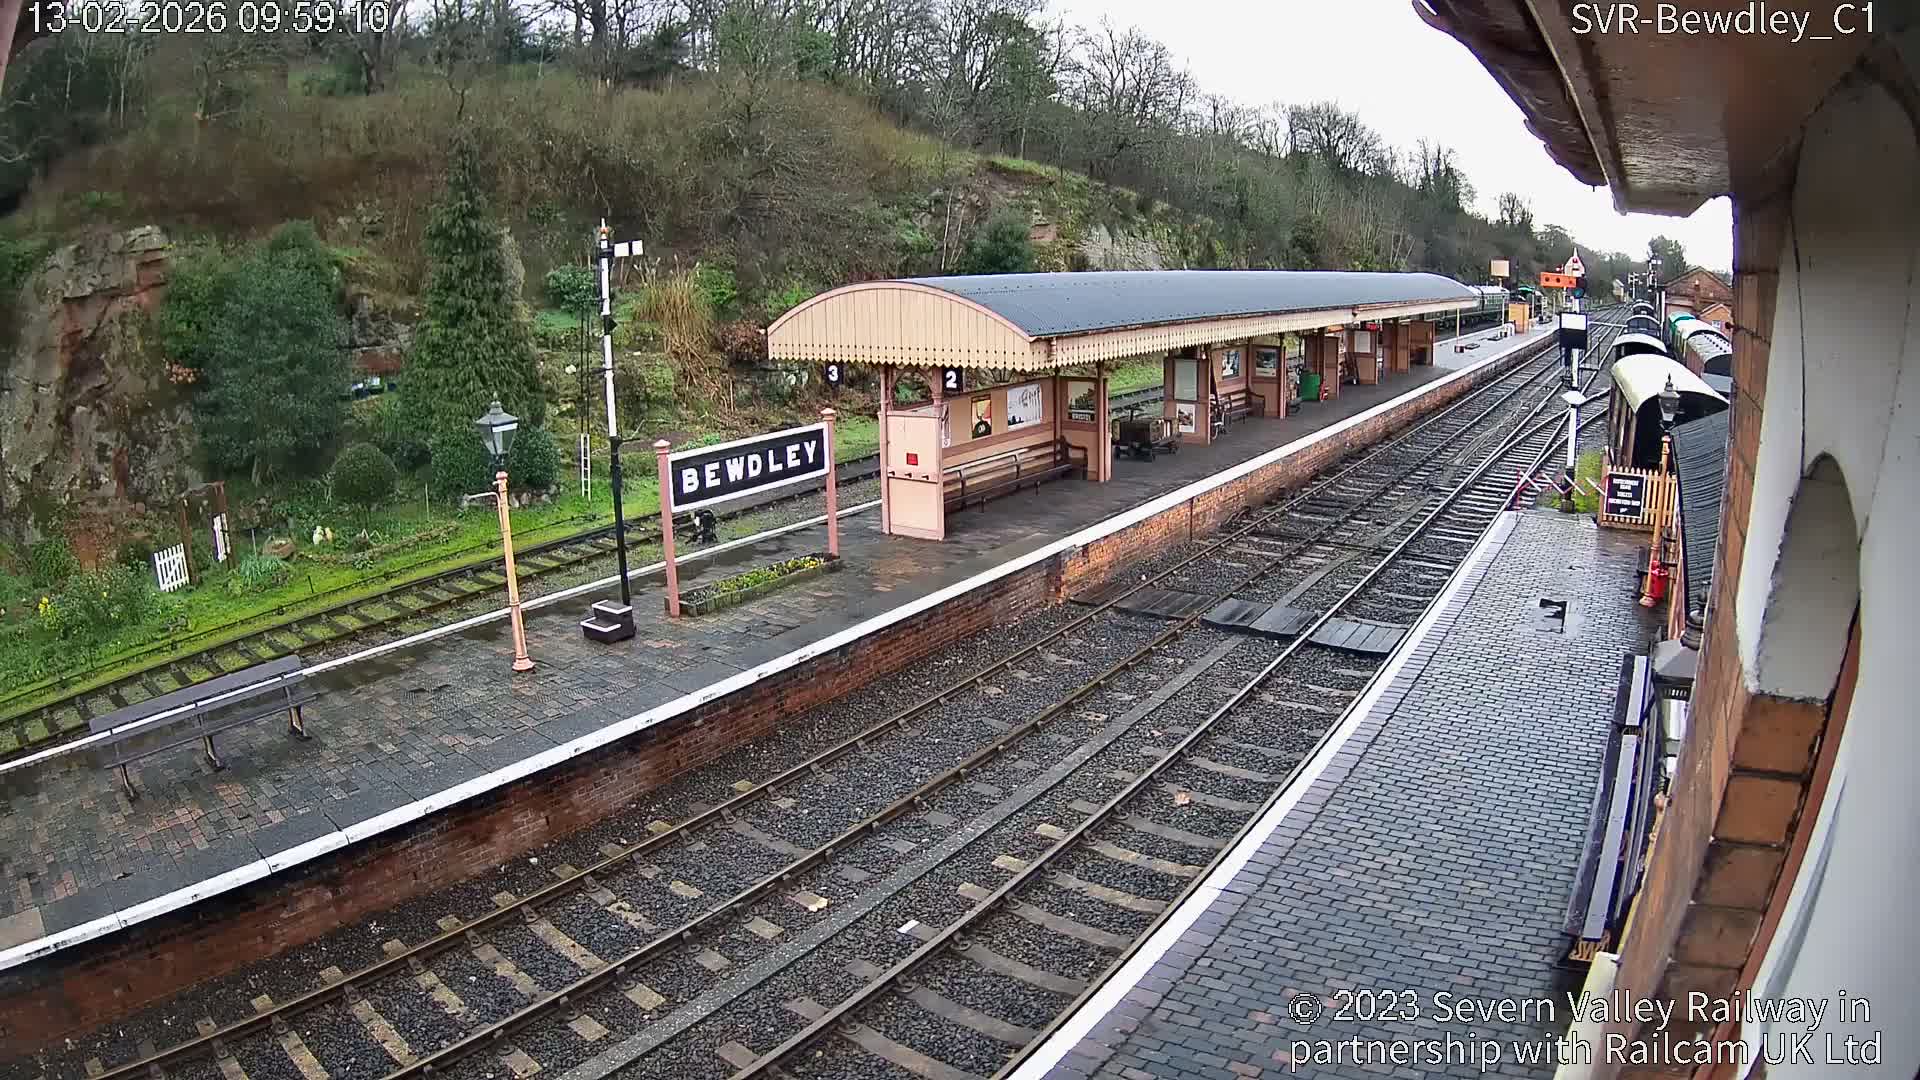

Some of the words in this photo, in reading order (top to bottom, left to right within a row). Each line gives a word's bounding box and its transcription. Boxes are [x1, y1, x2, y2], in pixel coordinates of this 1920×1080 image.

[828, 365, 839, 381] 3
[945, 371, 957, 388] 2
[681, 440, 816, 494] BEWDLEY
